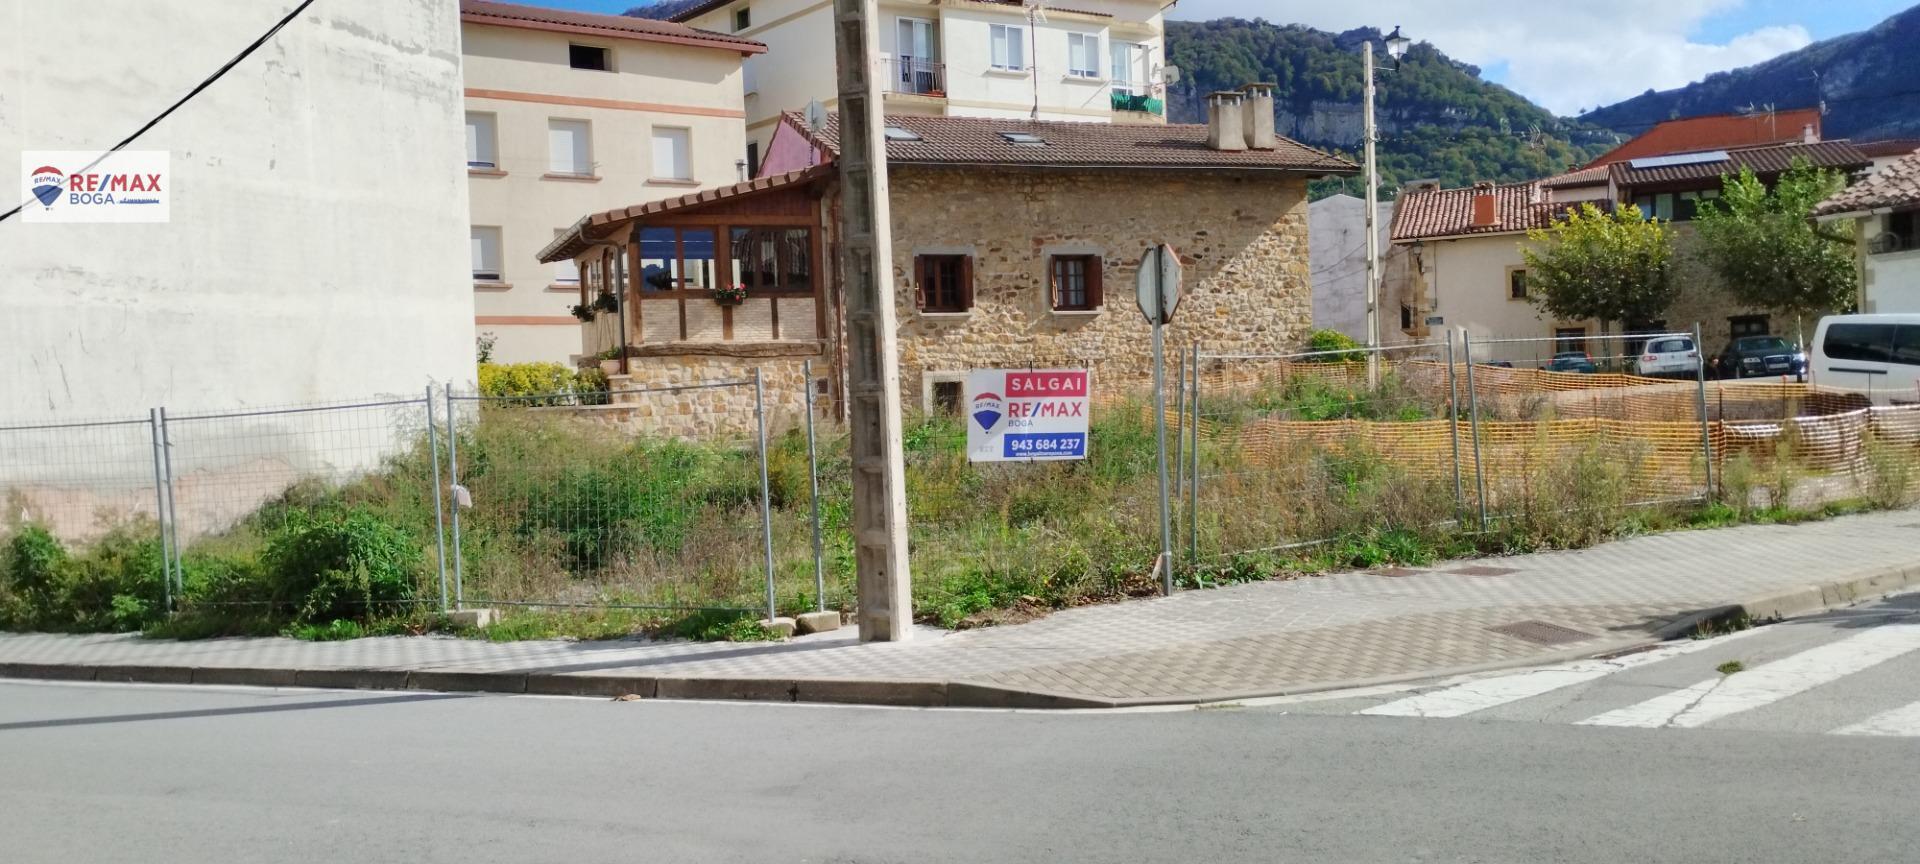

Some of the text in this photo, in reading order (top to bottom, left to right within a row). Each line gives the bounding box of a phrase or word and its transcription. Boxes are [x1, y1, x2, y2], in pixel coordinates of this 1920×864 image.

[1011, 377, 1081, 391] SALGAI
[1008, 402, 1082, 418] RE/MAX
[1008, 420, 1034, 428] BOGA
[1011, 438, 1081, 451] 943 684 237
